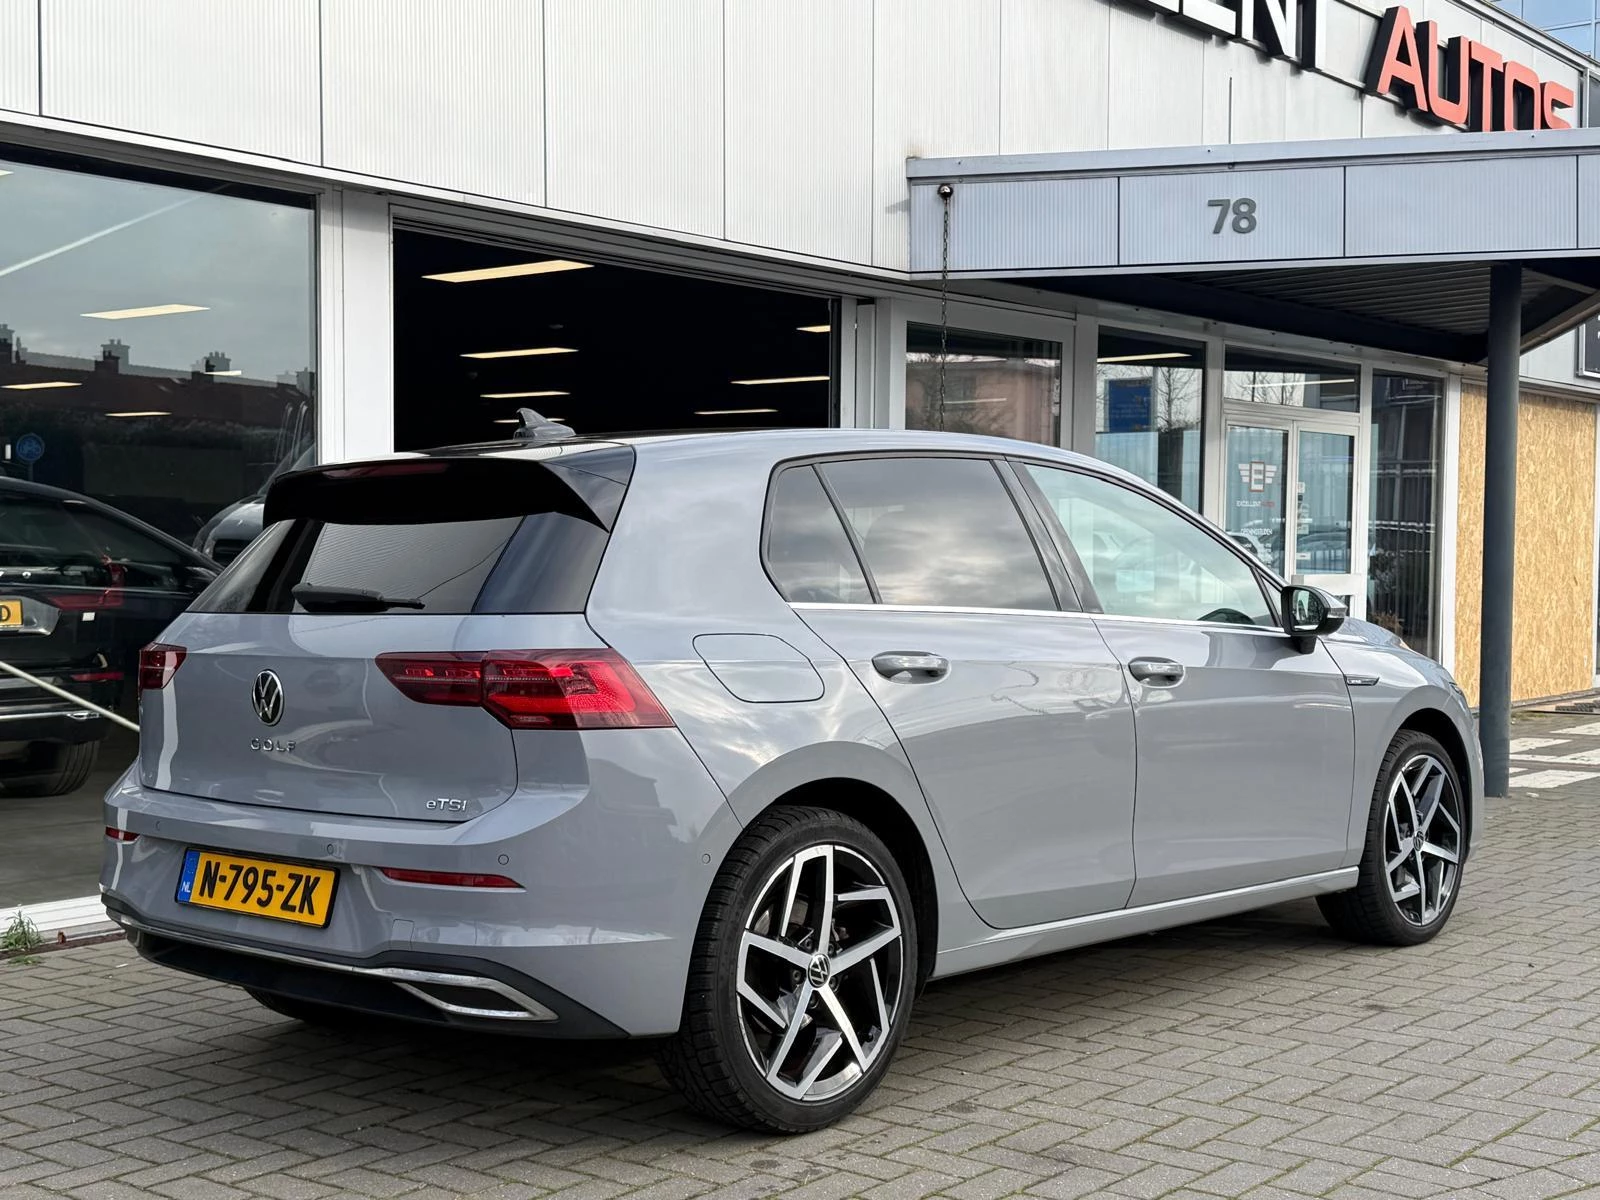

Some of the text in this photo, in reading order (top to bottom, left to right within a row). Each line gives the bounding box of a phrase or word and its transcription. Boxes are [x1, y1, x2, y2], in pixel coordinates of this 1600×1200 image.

[1376, 5, 1575, 133] AUTOS
[1207, 197, 1257, 234] 78
[250, 738, 297, 752] GOLF
[426, 798, 467, 811] eTSI
[181, 881, 192, 893] NL
[199, 860, 321, 916] N-795-ZK
